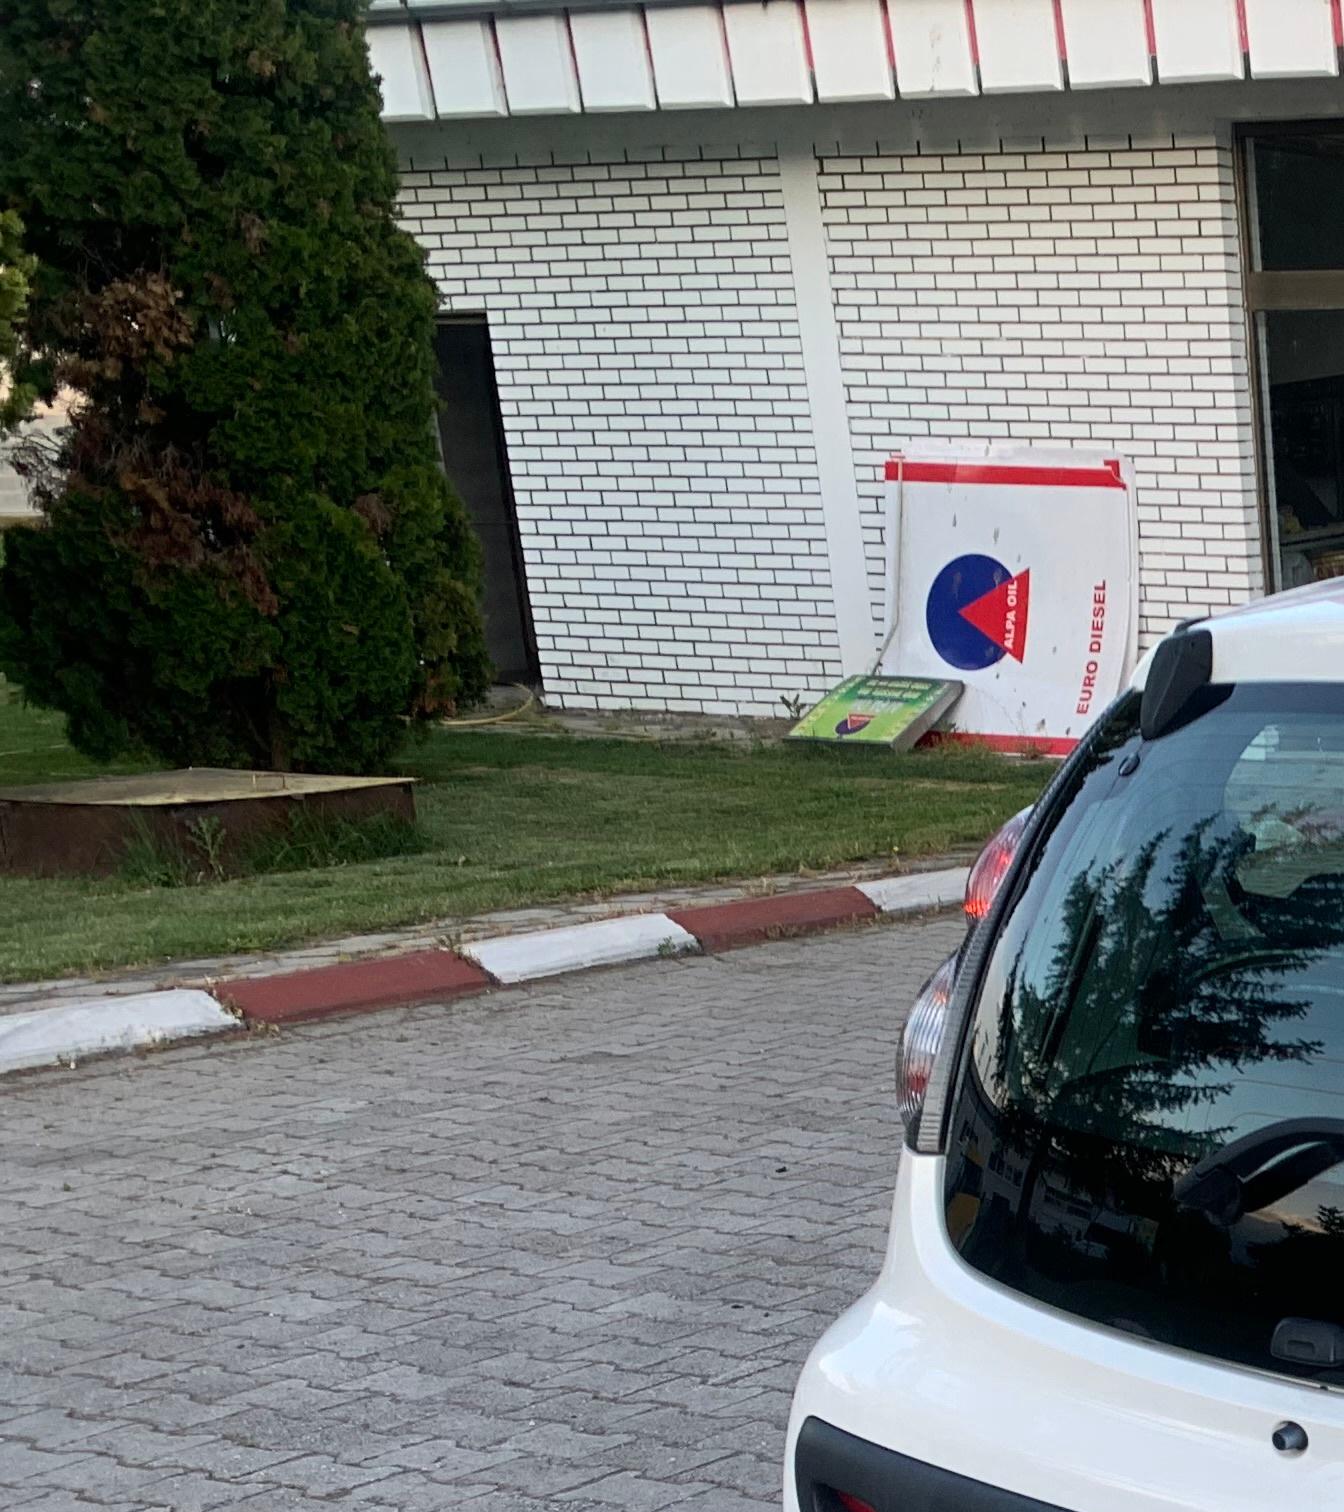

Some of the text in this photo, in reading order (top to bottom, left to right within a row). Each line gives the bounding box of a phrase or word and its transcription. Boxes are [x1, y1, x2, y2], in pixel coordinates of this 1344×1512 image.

[1003, 578, 1018, 649] ALPA OIL
[1076, 579, 1106, 715] EURO DIESEL
